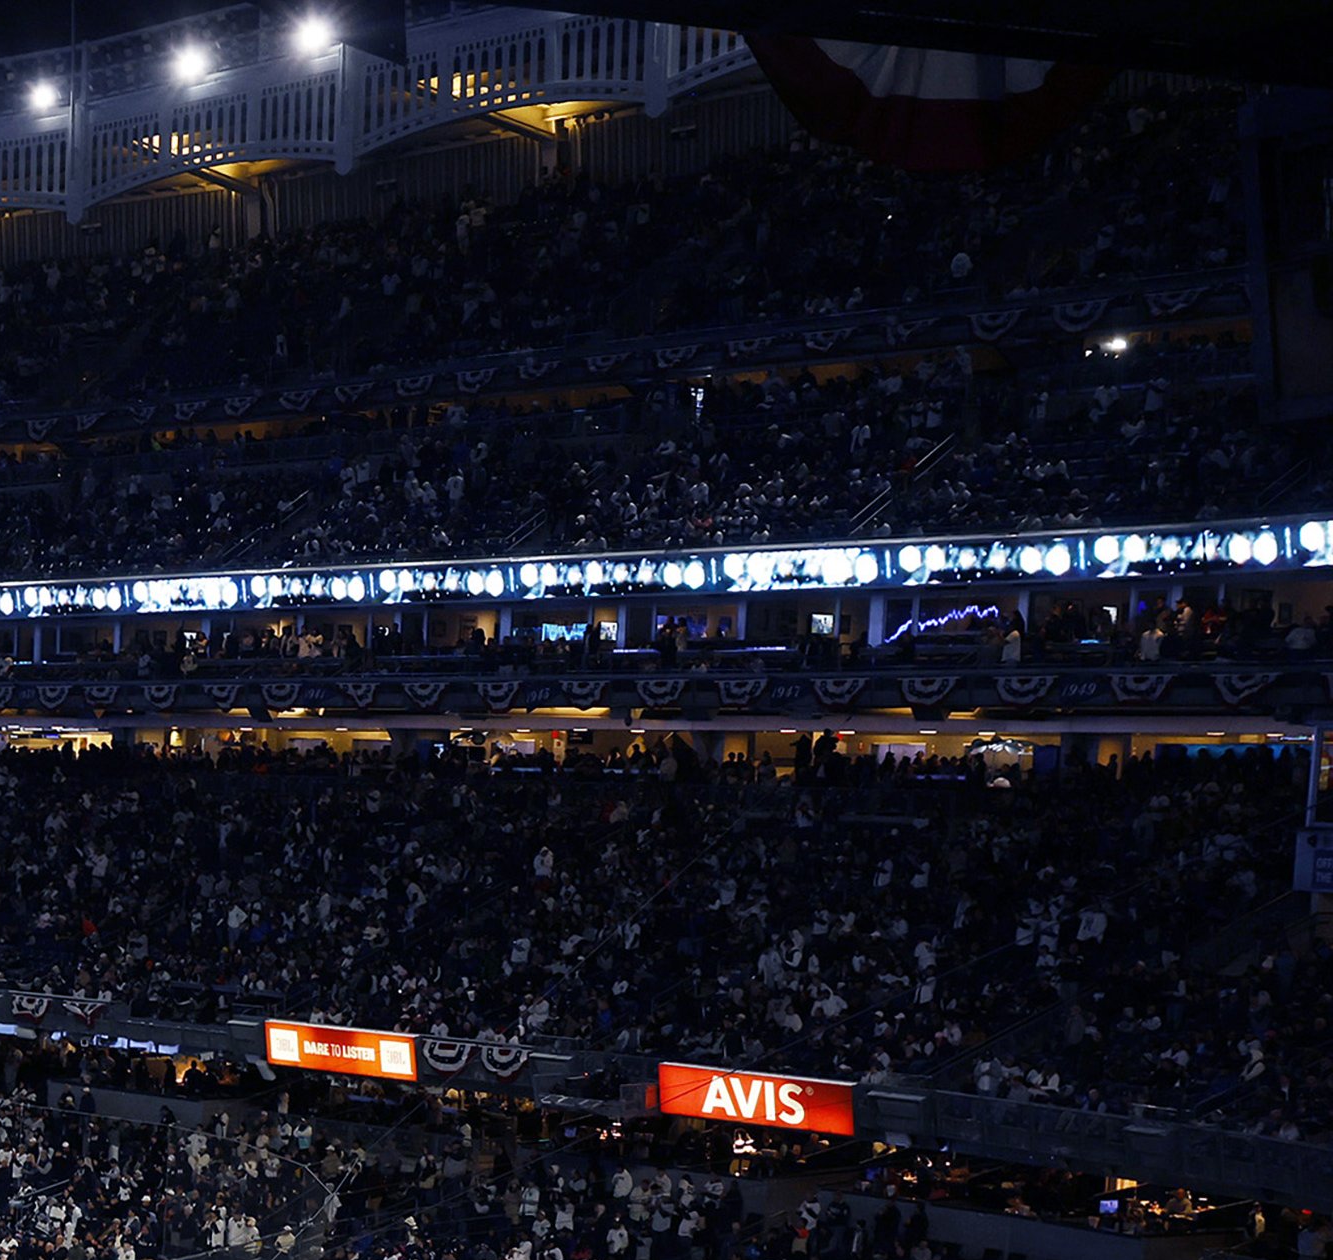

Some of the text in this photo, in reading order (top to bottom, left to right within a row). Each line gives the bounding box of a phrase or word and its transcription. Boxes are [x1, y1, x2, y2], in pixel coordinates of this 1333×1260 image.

[1060, 681, 1097, 697] 1949
[303, 1040, 330, 1055] DARE
[330, 1044, 341, 1057] TO
[701, 1075, 805, 1125] AVIS
